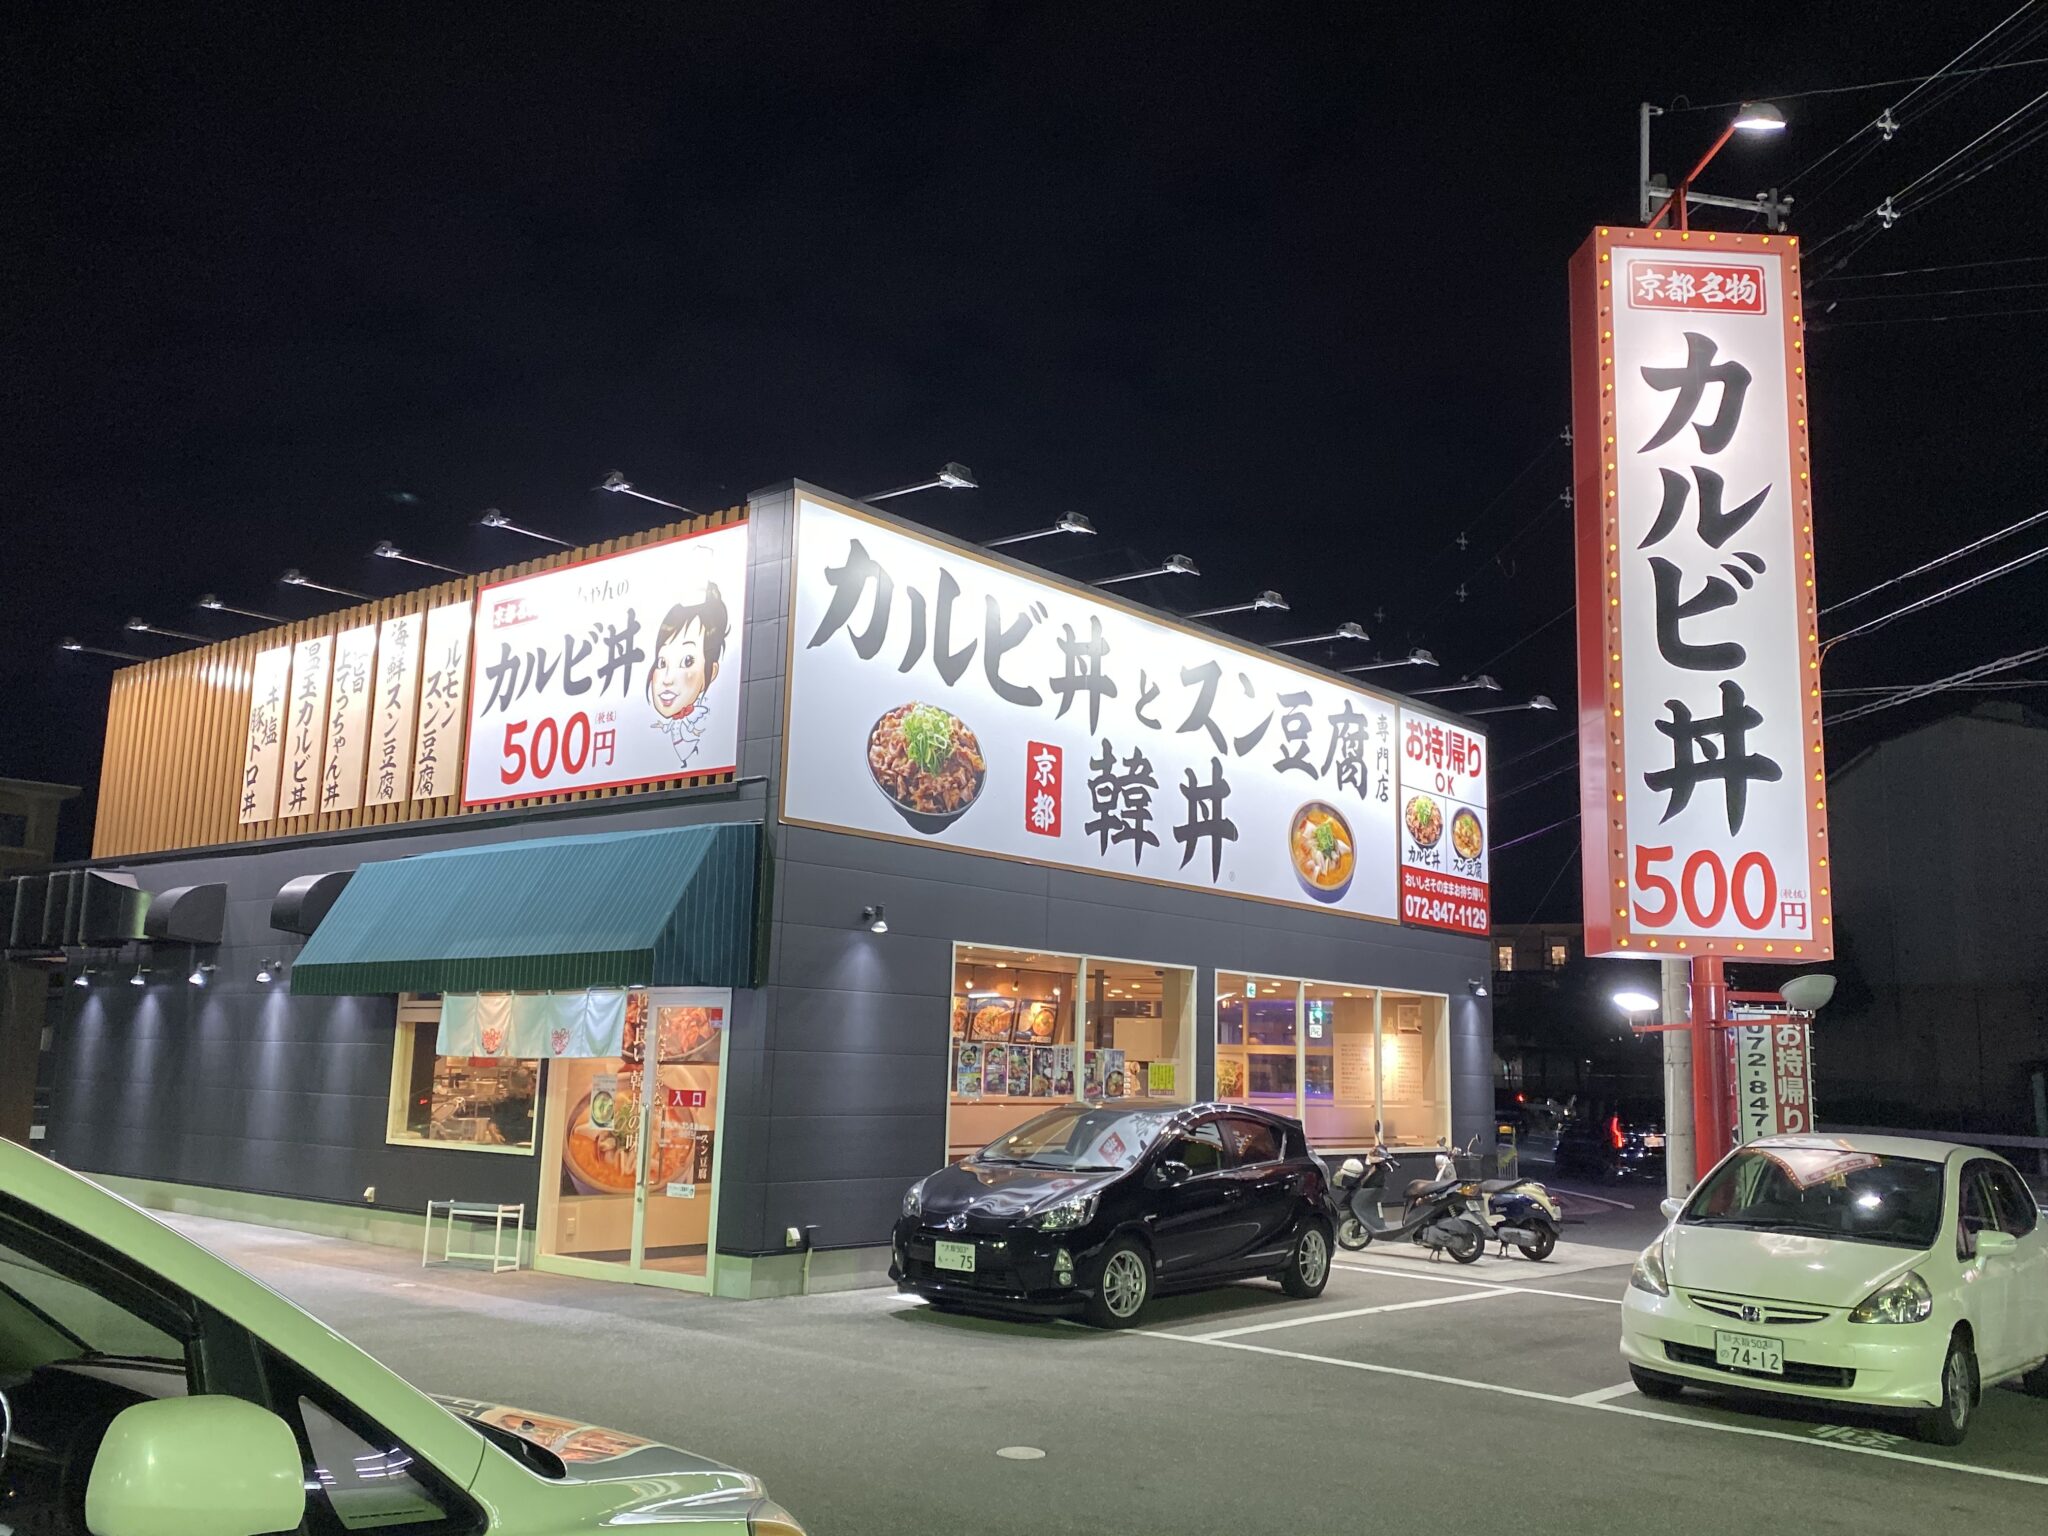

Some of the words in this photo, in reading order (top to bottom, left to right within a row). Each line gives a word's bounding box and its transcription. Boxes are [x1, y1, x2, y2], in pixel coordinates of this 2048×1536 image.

[1635, 268, 1757, 304] 京都名物
[1638, 332, 1783, 837] カルビ丼
[480, 608, 645, 718] カルビ丼
[807, 538, 1369, 801] カルビ丼とスン豆腐
[377, 620, 409, 799] 海鮮スン豆腐
[416, 671, 442, 797] スン豆腐
[500, 711, 616, 785] 500円
[1406, 719, 1482, 778] お持帰り
[242, 704, 265, 819] 豚トロ丼
[1032, 747, 1056, 832] 京都
[1376, 713, 1389, 802] 専門店
[1435, 772, 1455, 796] OK
[1085, 738, 1239, 885] 韓丼
[1408, 846, 1440, 870] カルビ丼
[1453, 859, 1482, 879] スン豆腐
[1633, 844, 1807, 931] 500円
[1405, 894, 1487, 930] 072-847-1129
[672, 1091, 703, 1106] 入口
[1776, 1023, 1806, 1134] お持帰り
[1731, 1347, 1779, 1370] 74-12
